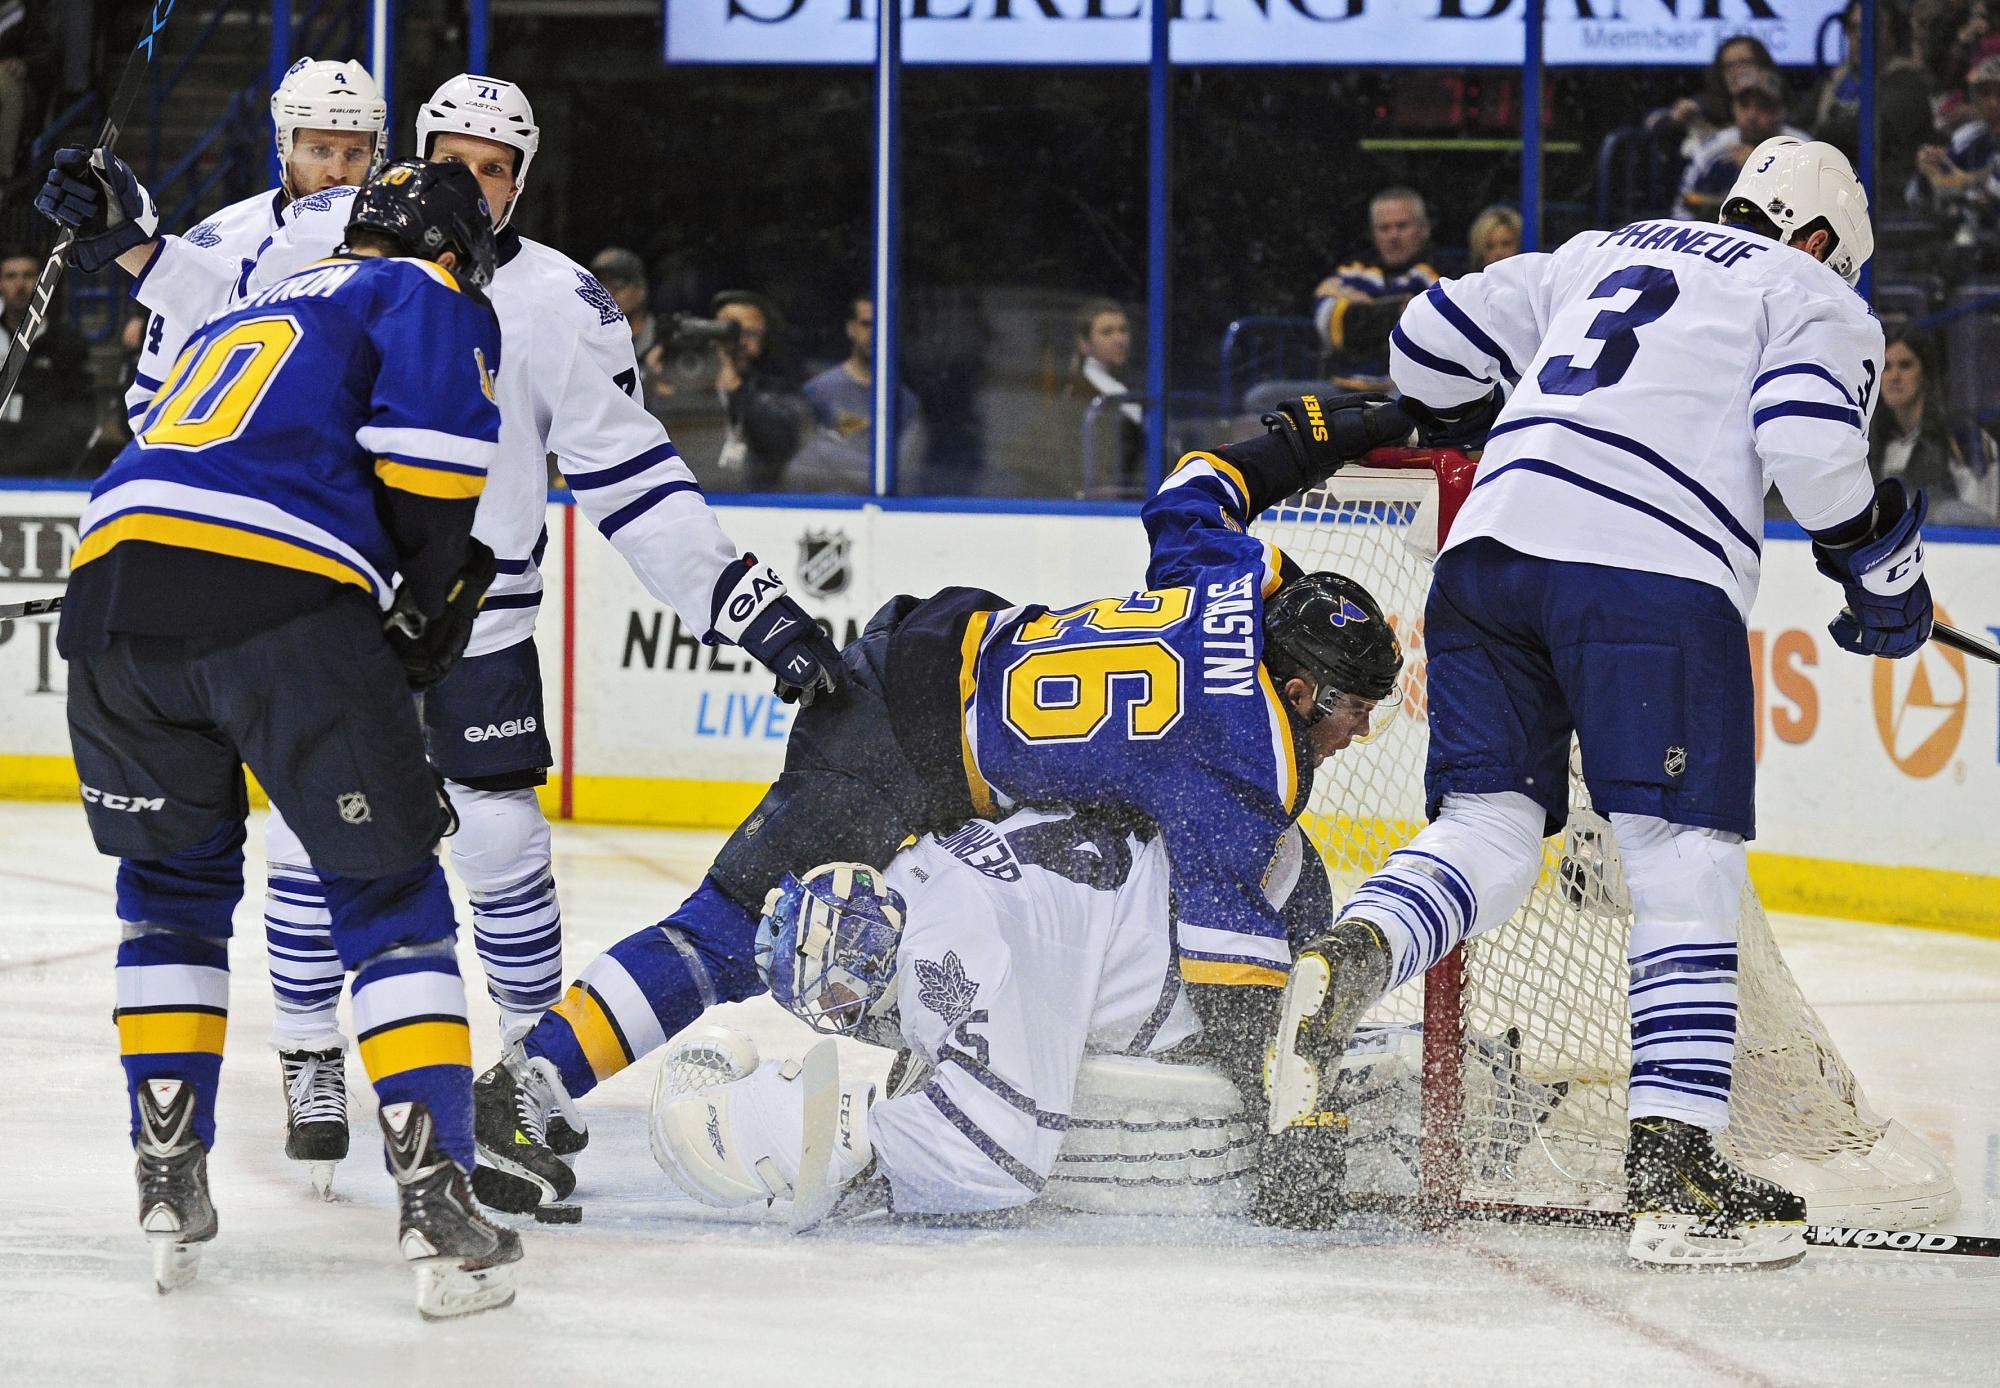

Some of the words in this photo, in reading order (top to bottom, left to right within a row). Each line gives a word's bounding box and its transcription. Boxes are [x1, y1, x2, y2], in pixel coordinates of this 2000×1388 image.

[334, 73, 347, 84] 4
[477, 85, 498, 101] 71
[1757, 156, 1775, 174] 3
[1597, 223, 1770, 269] PHANEUF
[147, 310, 165, 355] 4
[1537, 264, 1681, 396] 3
[1857, 358, 1876, 417] 3
[1301, 393, 1329, 442] SHER
[1203, 572, 1255, 696] STASTNY
[788, 654, 811, 675] 71
[1003, 586, 1197, 746] 26
[696, 690, 788, 739] LIVE
[81, 782, 166, 812] CCM
[840, 1093, 852, 1151] CCM
